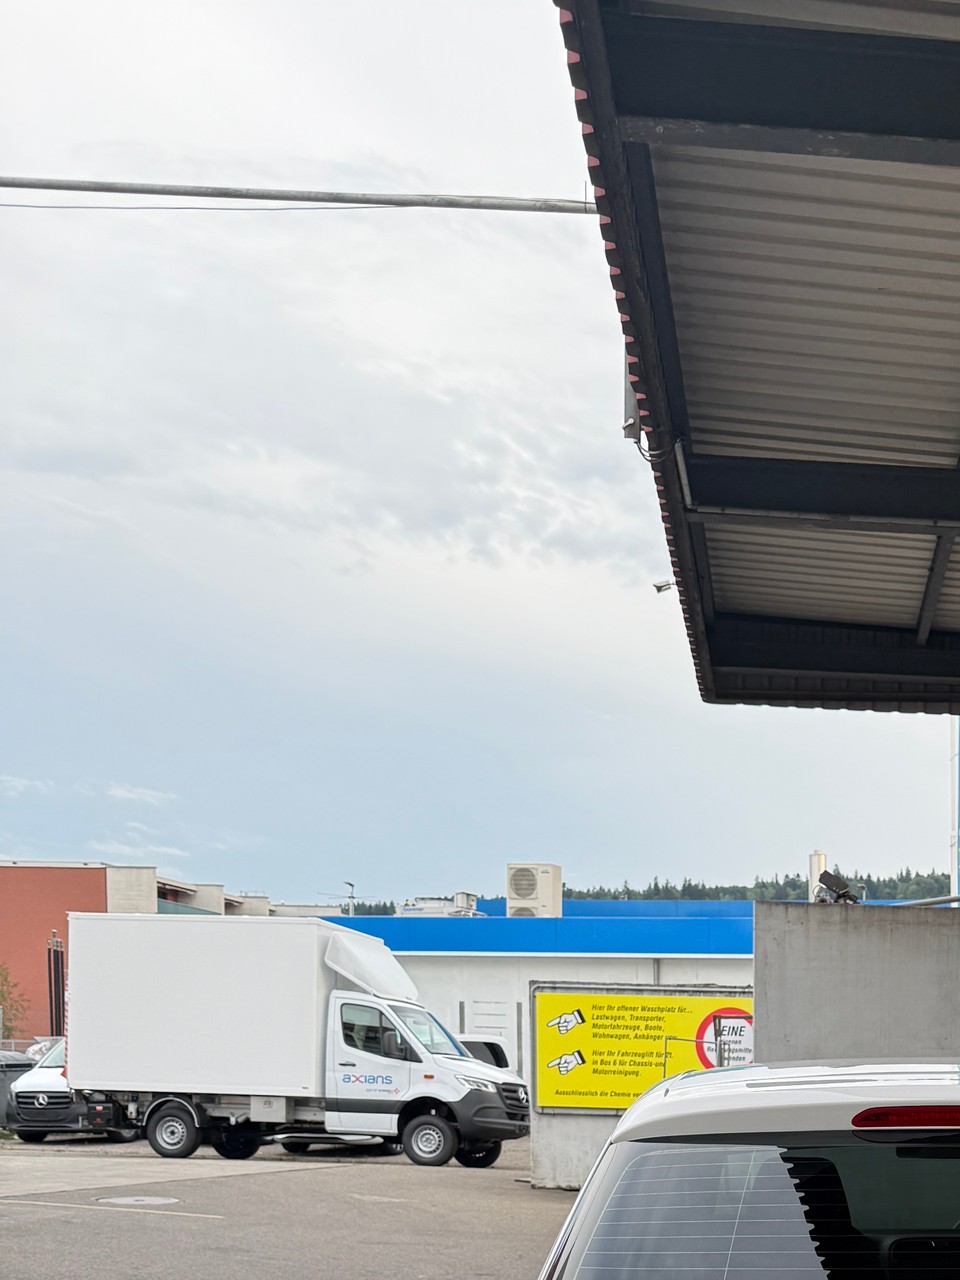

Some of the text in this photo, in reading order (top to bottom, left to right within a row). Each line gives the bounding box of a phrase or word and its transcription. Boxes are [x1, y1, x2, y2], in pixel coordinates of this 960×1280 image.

[592, 1014, 666, 1023] Lastwagen, Transporter,
[592, 1023, 642, 1032] Motorfahrzeuge,
[720, 1025, 746, 1036] EINE
[592, 1032, 632, 1040] Wohnwagen,
[633, 1033, 664, 1041] Anhänger
[617, 1050, 655, 1059] Fahrzeuglift
[342, 1074, 393, 1084] axians
